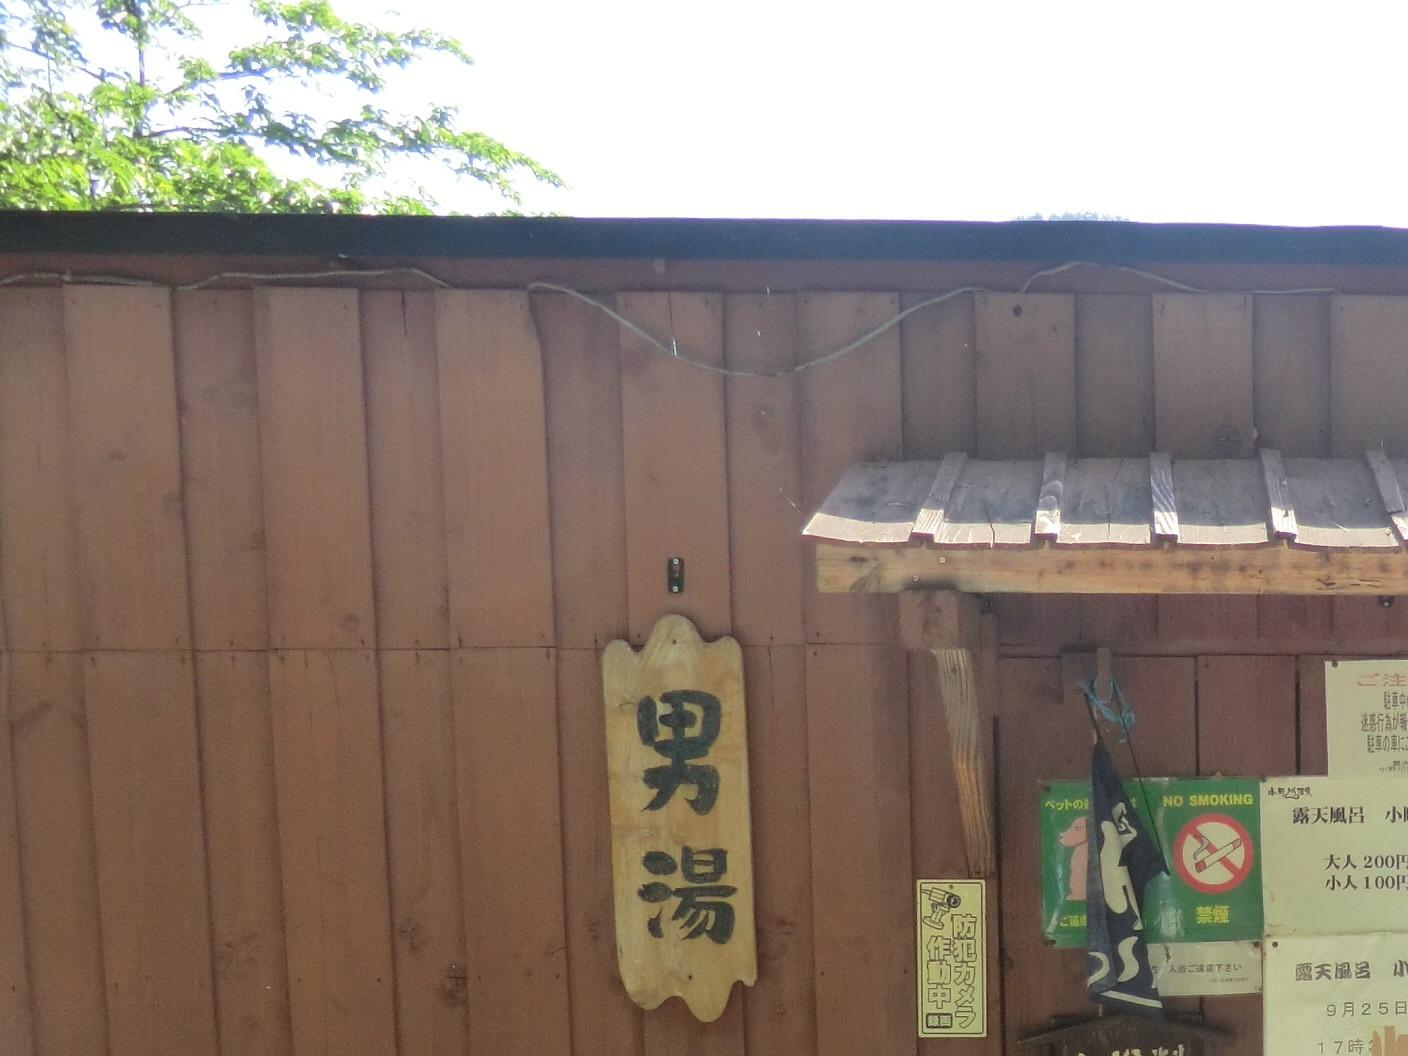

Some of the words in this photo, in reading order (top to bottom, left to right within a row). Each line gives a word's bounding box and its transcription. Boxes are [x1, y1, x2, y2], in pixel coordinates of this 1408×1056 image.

[1163, 795, 1185, 808] NO
[1190, 793, 1254, 807] SMOKING
[637, 689, 738, 945] 男湯
[1292, 806, 1365, 824] 露天風呂
[1324, 854, 1357, 870] 大人
[1324, 875, 1358, 891] 小人
[1195, 904, 1230, 925] 禁煙
[926, 935, 952, 1010] 作動中
[951, 913, 977, 1029] 防犯カメラ
[1295, 961, 1371, 981] 露天風呂
